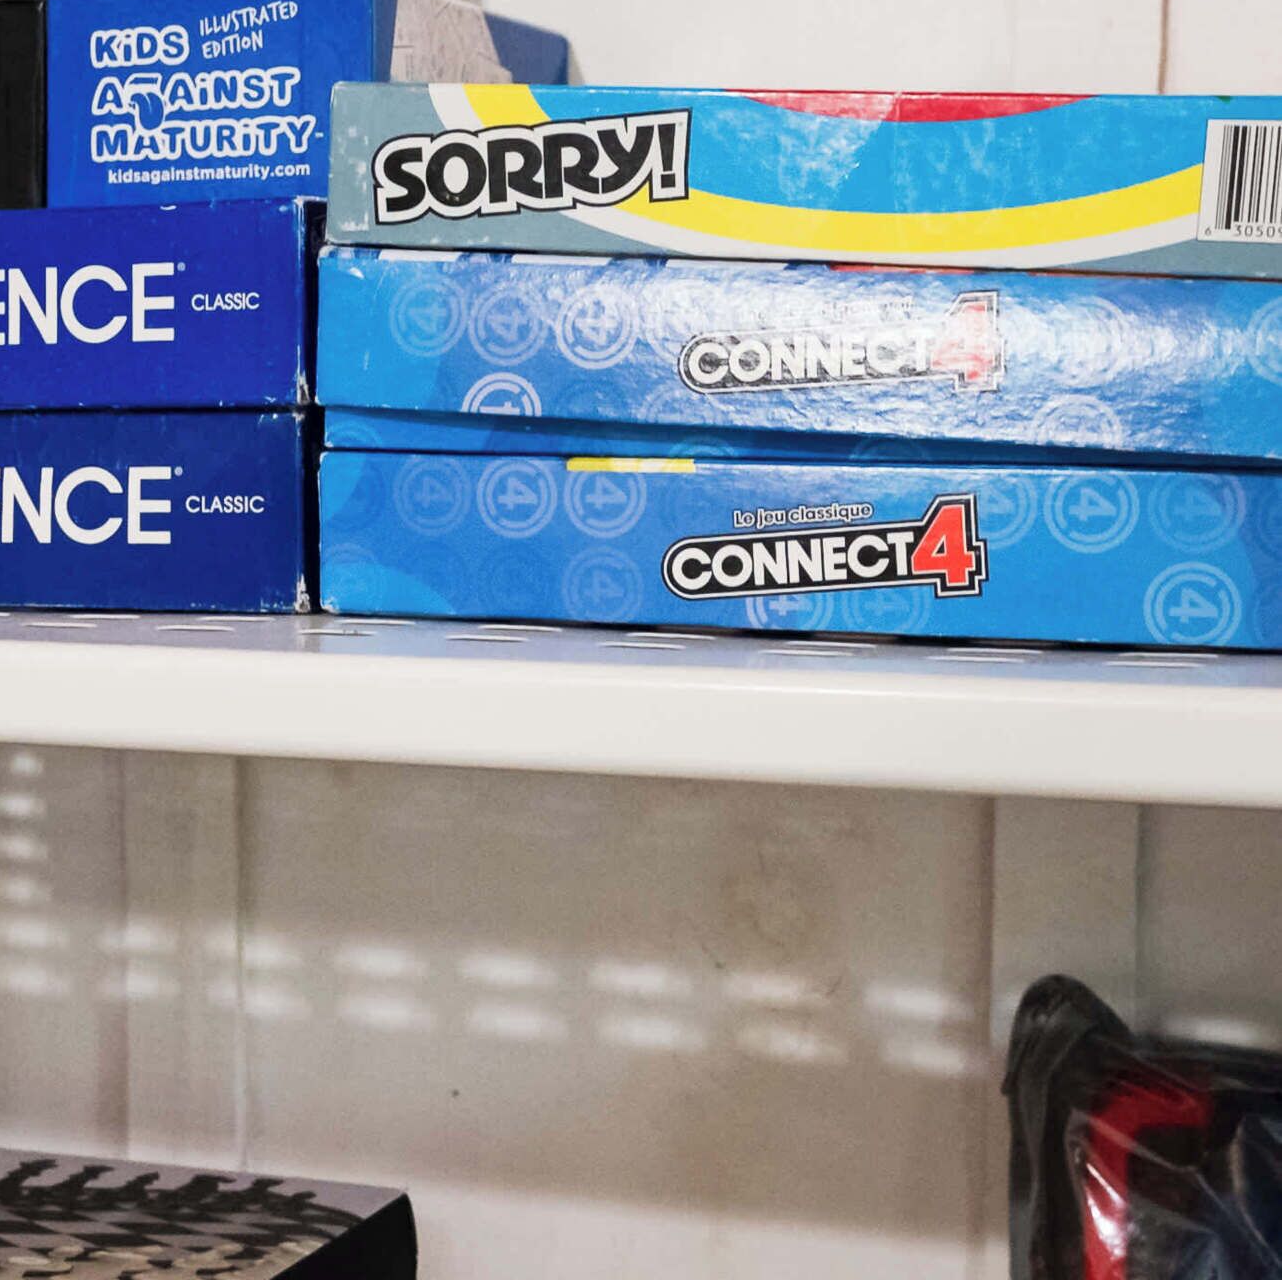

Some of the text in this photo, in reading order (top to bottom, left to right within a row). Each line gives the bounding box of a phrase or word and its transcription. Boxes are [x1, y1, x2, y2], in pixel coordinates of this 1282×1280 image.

[107, 163, 311, 185] kidsagainstmaturity.com
[380, 118, 680, 217] SORRY!
[191, 291, 260, 312] CLASSIC
[185, 493, 265, 515] CLASSIC
[733, 501, 874, 529] Le jeu classique
[671, 504, 975, 591] CONNECT 4
